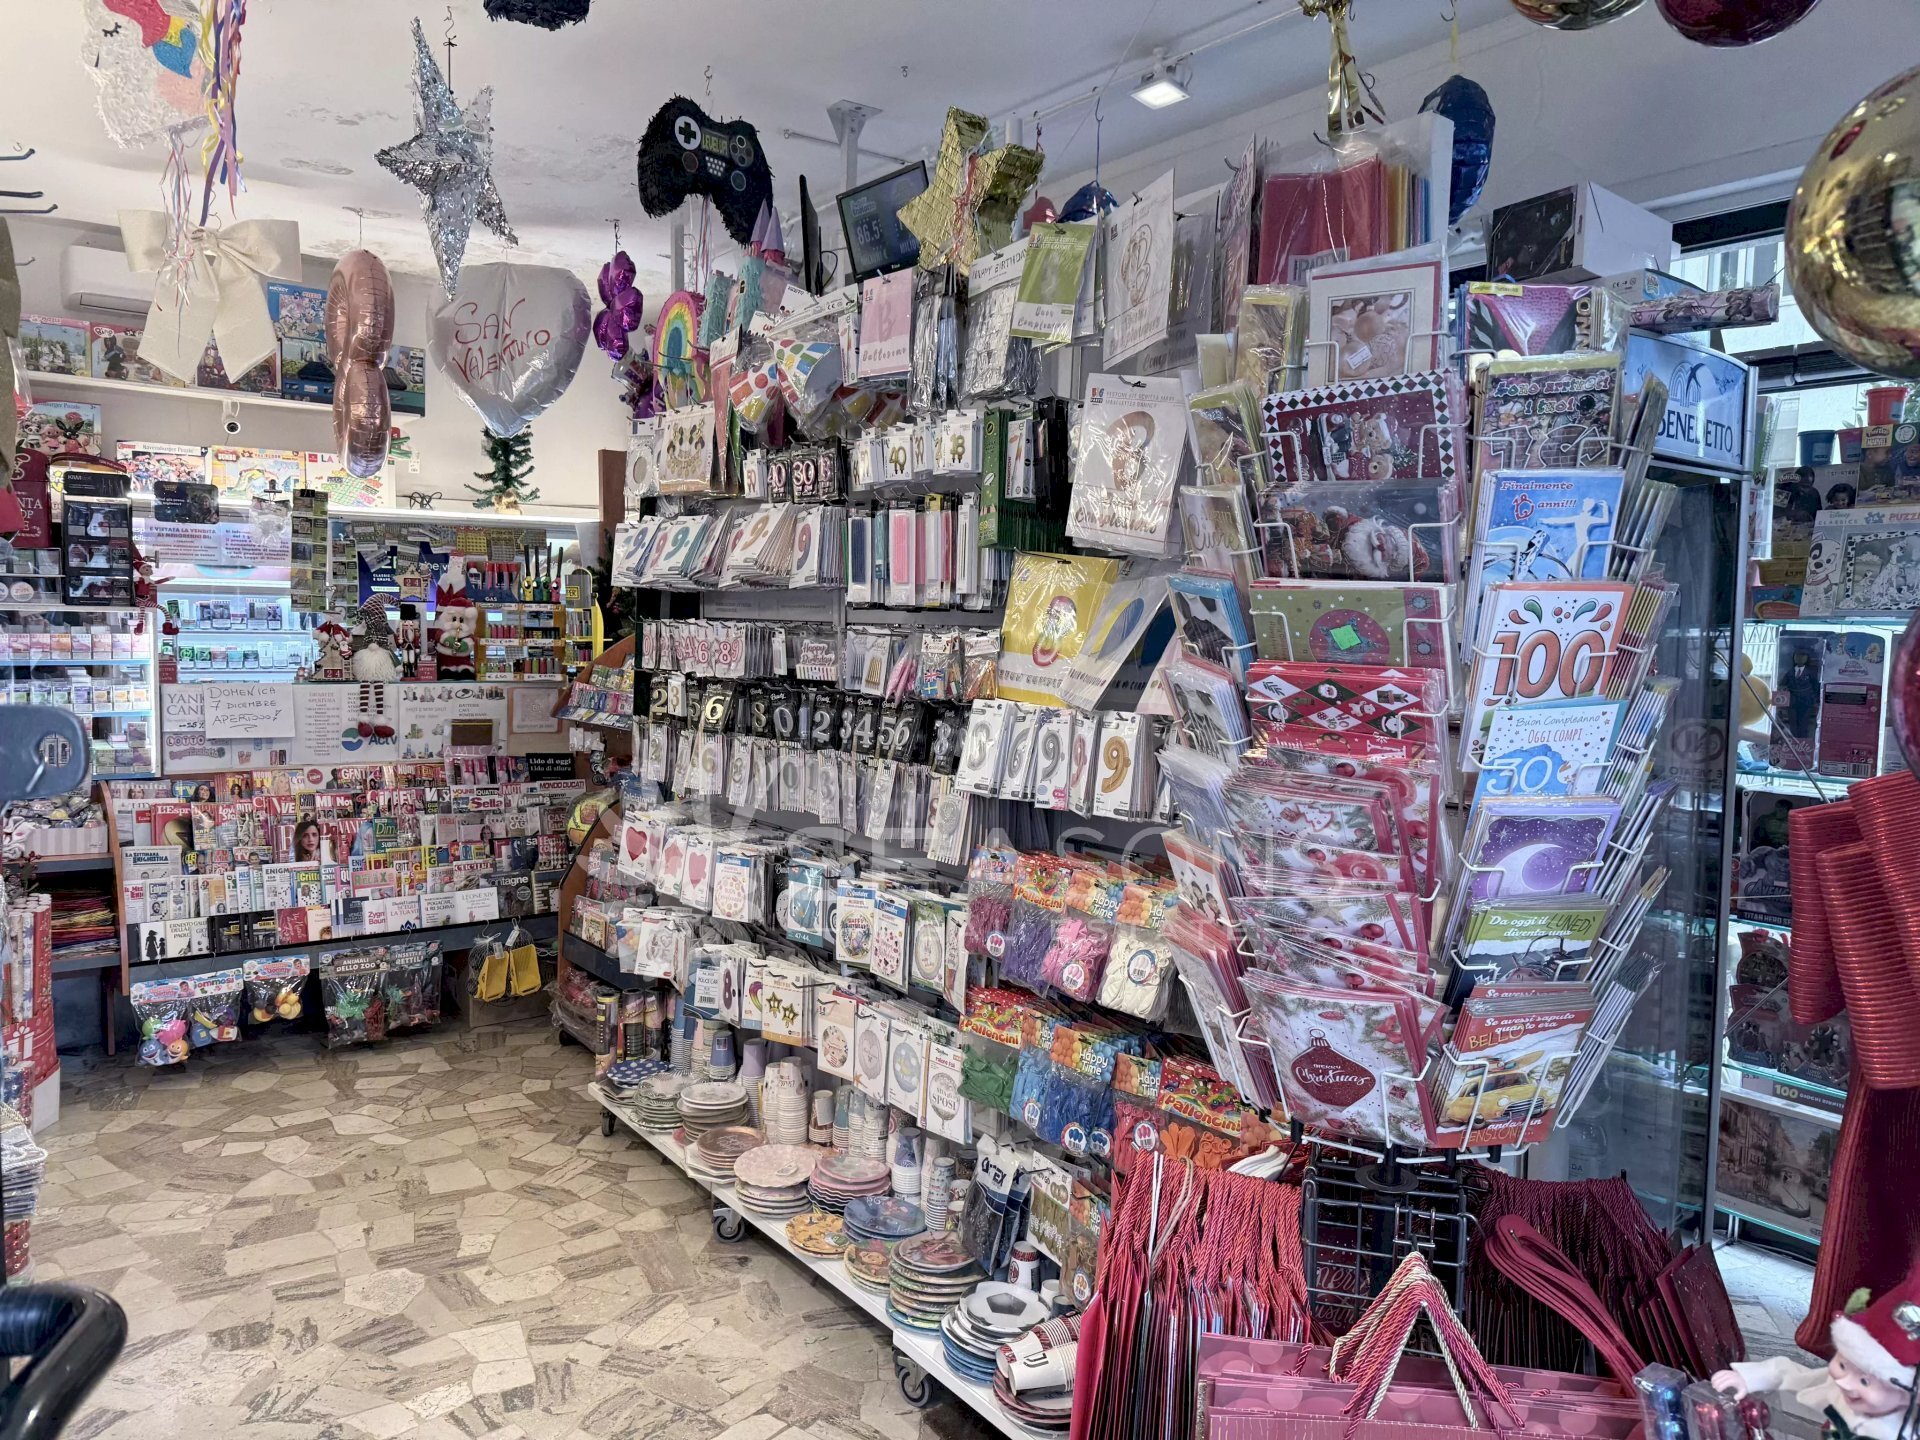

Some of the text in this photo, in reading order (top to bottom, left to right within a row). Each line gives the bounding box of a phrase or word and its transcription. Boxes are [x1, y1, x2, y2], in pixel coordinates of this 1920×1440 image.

[454, 298, 525, 344] SAN
[452, 329, 550, 383] VALENTINO
[1501, 481, 1573, 491] Finalmente
[1538, 498, 1576, 509] anni!!!
[1492, 629, 1606, 698] 100
[207, 686, 276, 699] DOMENICA
[227, 701, 277, 710] DICEMBRE
[1515, 714, 1601, 728] Buon Compleanno
[166, 735, 206, 746] LOTTO
[1527, 727, 1583, 744] OGGI COMPI
[1101, 735, 1131, 794] 9
[1486, 755, 1553, 796] 30
[1092, 893, 1120, 911] Happy
[1093, 904, 1113, 919] Time
[1744, 912, 1763, 920] TITAN
[1764, 914, 1777, 923] HERO
[1489, 915, 1507, 926] Da
[1509, 917, 1533, 928] oggi
[1535, 915, 1547, 925] il
[1504, 927, 1546, 938] diventa
[336, 962, 376, 972] DELLO ZOO
[343, 957, 369, 966] ANIMALI
[1485, 1012, 1575, 1027] Se avessi saputo
[964, 1020, 1020, 1045] Palloncini
[1495, 1021, 1558, 1034] quanto era
[1468, 1023, 1525, 1049] BELLO
[1080, 1050, 1109, 1068] Happy
[1082, 1060, 1102, 1076] Time
[1295, 1065, 1371, 1086] Christmas
[1138, 1072, 1161, 1087] Happ
[1775, 1084, 1799, 1099] 100
[932, 1093, 956, 1111] SPOSI
[1164, 1093, 1242, 1133] Palloncini
[1530, 1118, 1542, 1127] in
